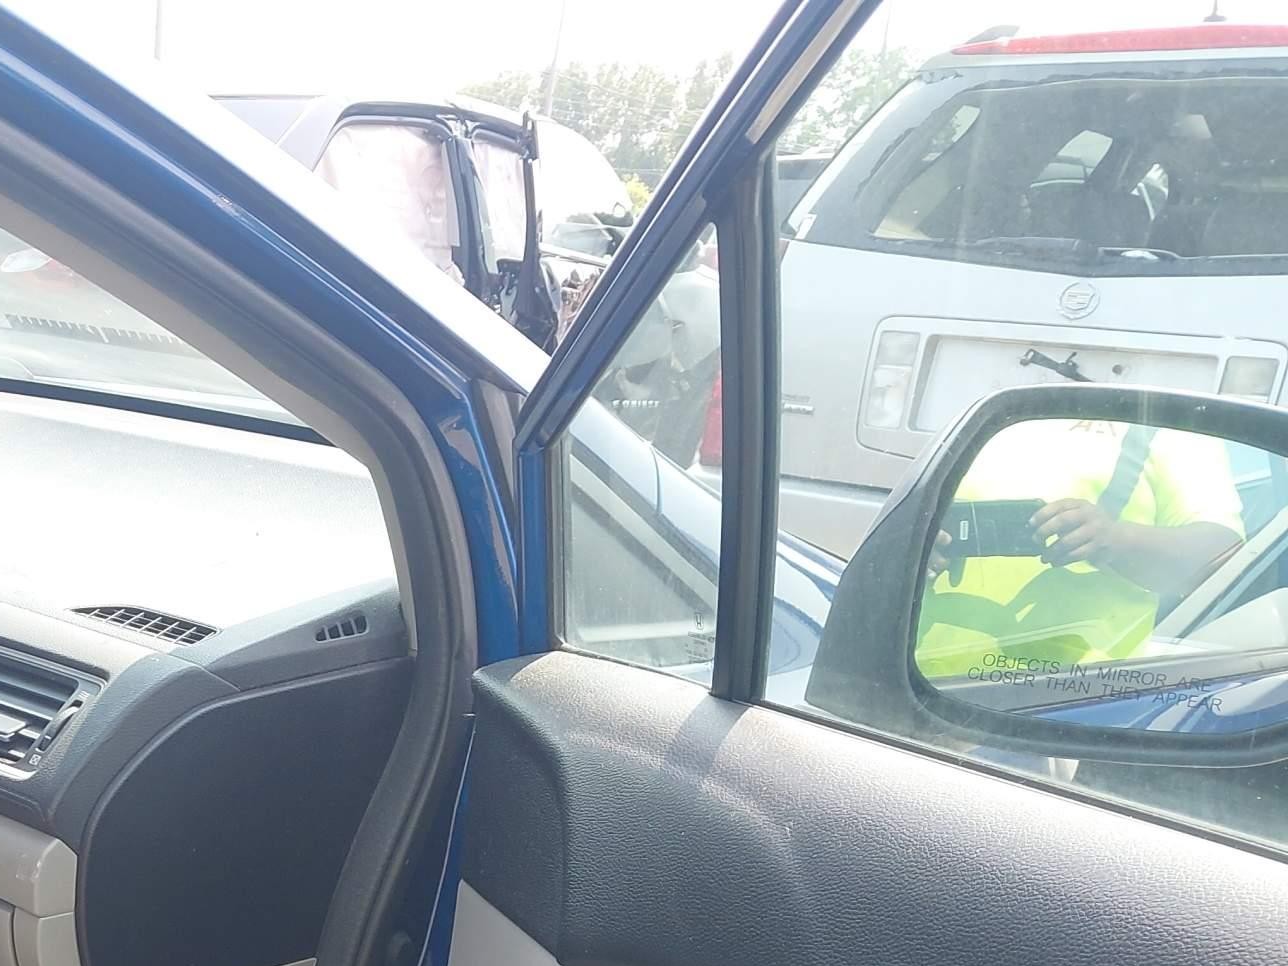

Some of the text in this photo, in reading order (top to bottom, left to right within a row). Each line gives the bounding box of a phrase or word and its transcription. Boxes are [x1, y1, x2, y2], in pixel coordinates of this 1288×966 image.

[967, 667, 1223, 712] CLOSER THAN THEY APPEAR
[982, 653, 1212, 692] OBJECTS IN MIRROR ARE
